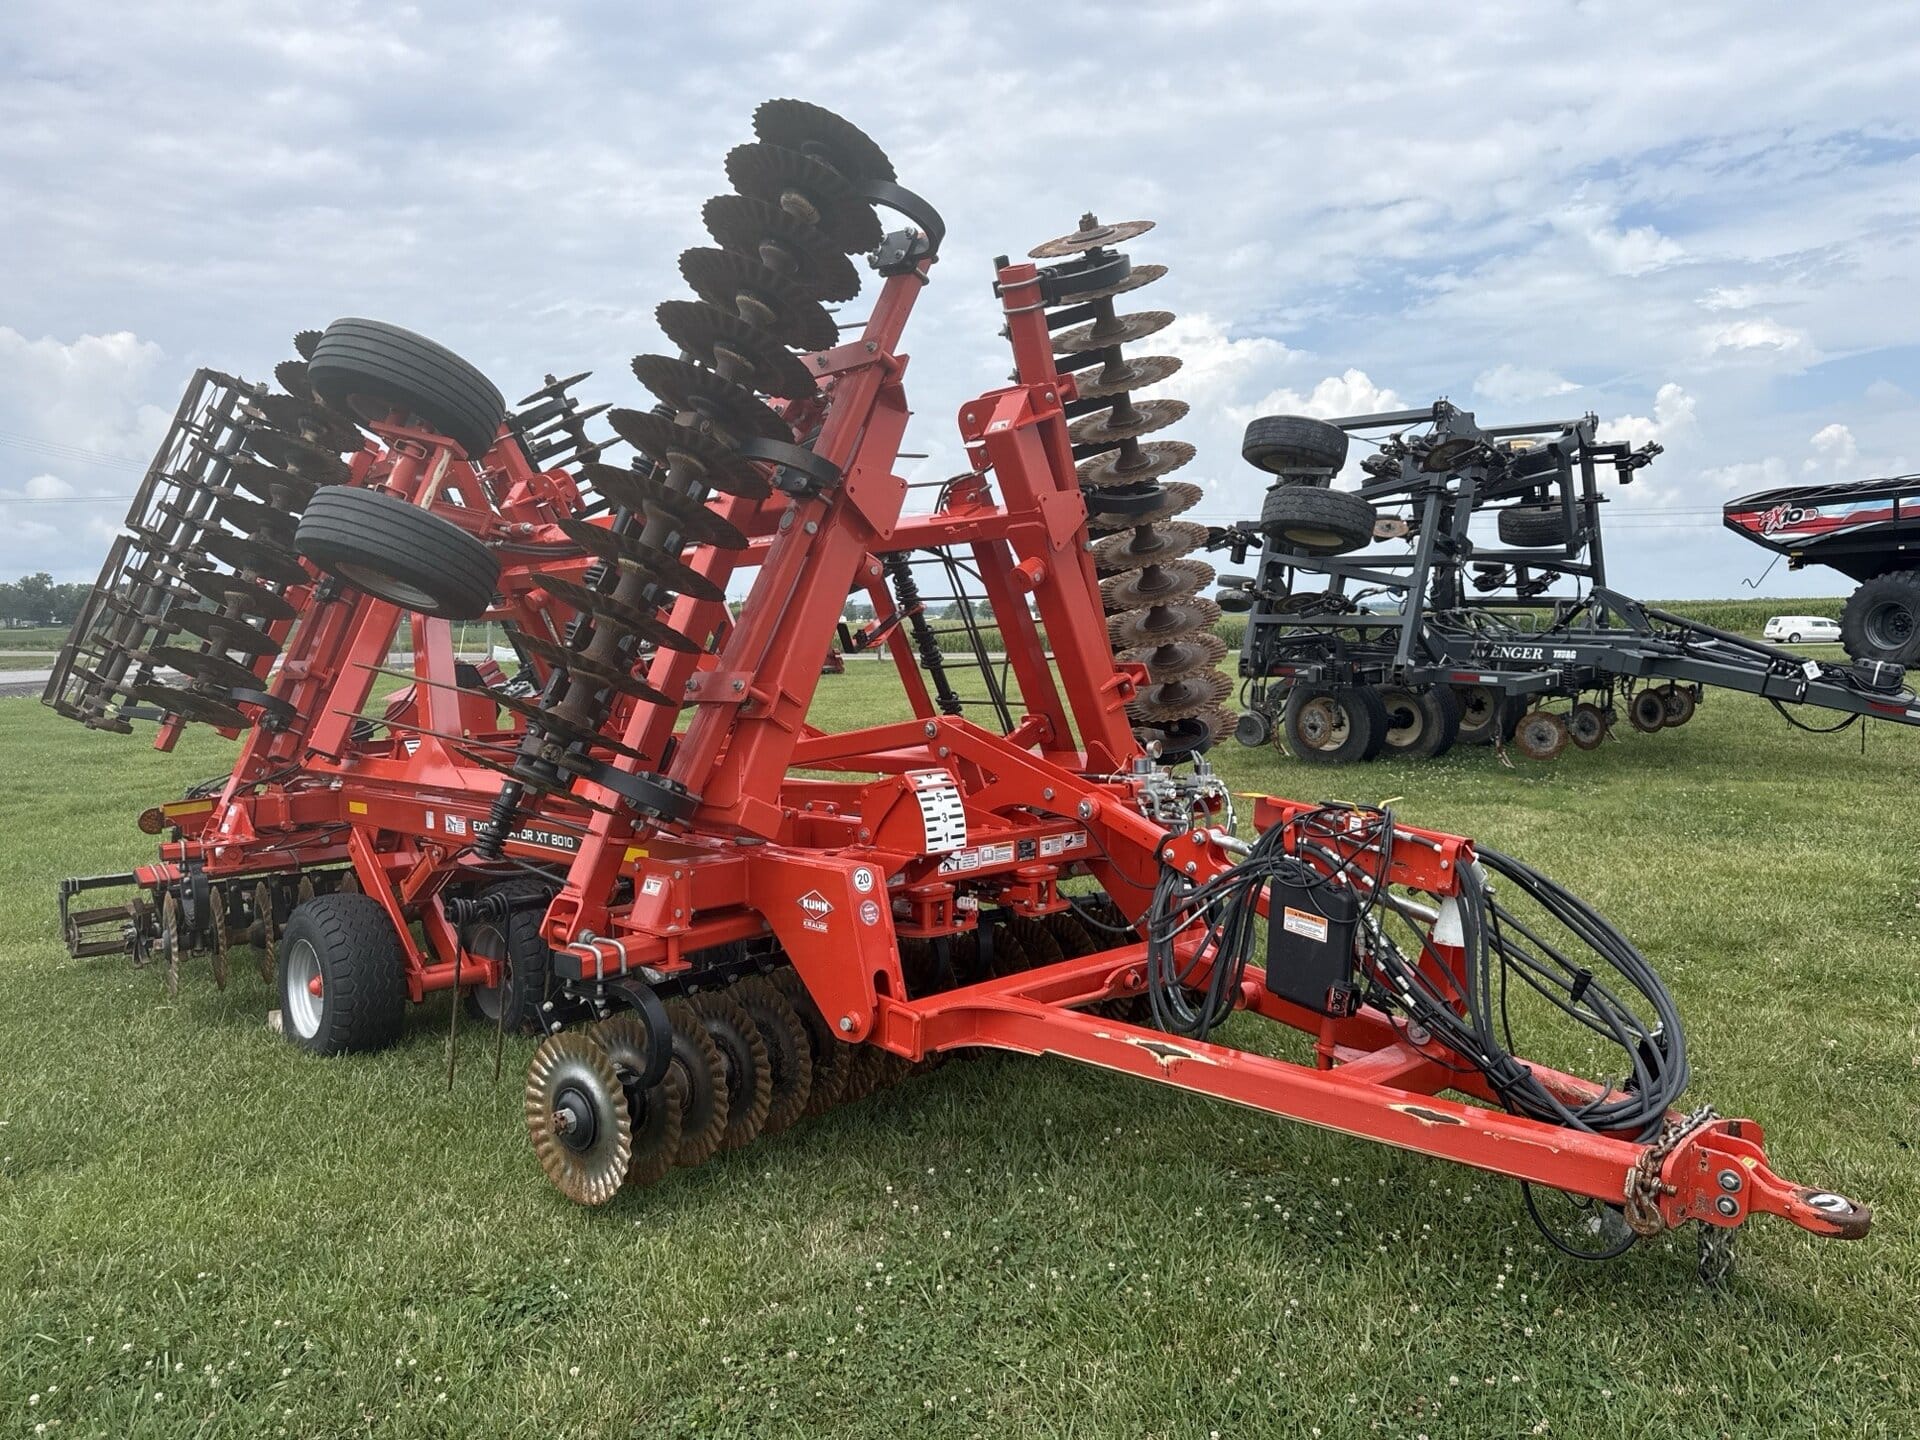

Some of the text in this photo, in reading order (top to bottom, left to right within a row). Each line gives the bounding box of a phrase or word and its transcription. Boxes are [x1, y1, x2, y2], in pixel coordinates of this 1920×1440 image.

[935, 792, 943, 802] 5
[941, 812, 948, 823] 3
[536, 831, 549, 844] XT
[551, 834, 574, 848] 8010
[944, 832, 949, 843] 1
[857, 873, 870, 885] 20
[803, 899, 828, 912] KUHN
